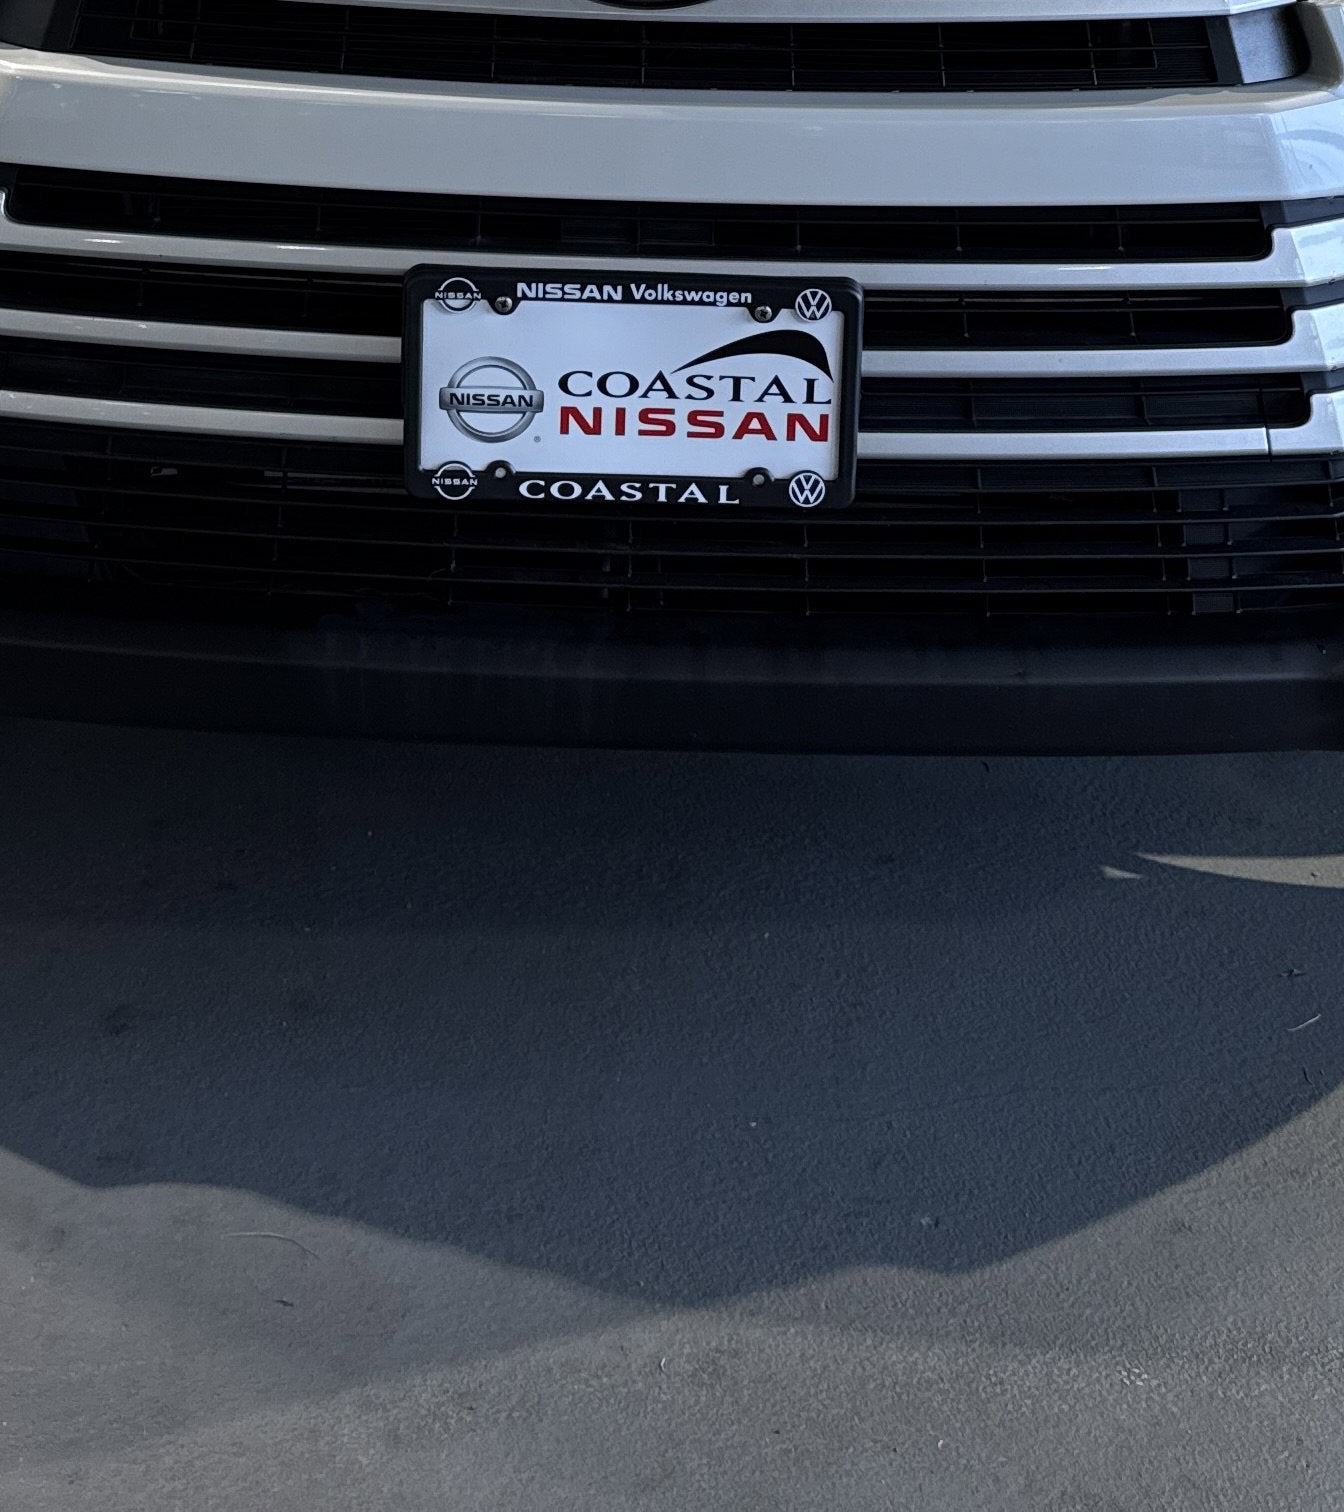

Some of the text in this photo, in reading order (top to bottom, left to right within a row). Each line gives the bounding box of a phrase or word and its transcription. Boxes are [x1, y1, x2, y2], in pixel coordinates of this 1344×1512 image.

[435, 291, 482, 300] NISSAN
[516, 282, 752, 306] NISSAN Volkswagen
[558, 370, 832, 405] COASTAL
[449, 392, 534, 408] NISSAN
[559, 406, 829, 442] NISSAN
[431, 477, 478, 486] NISSAN
[518, 479, 740, 504] COASTAL
